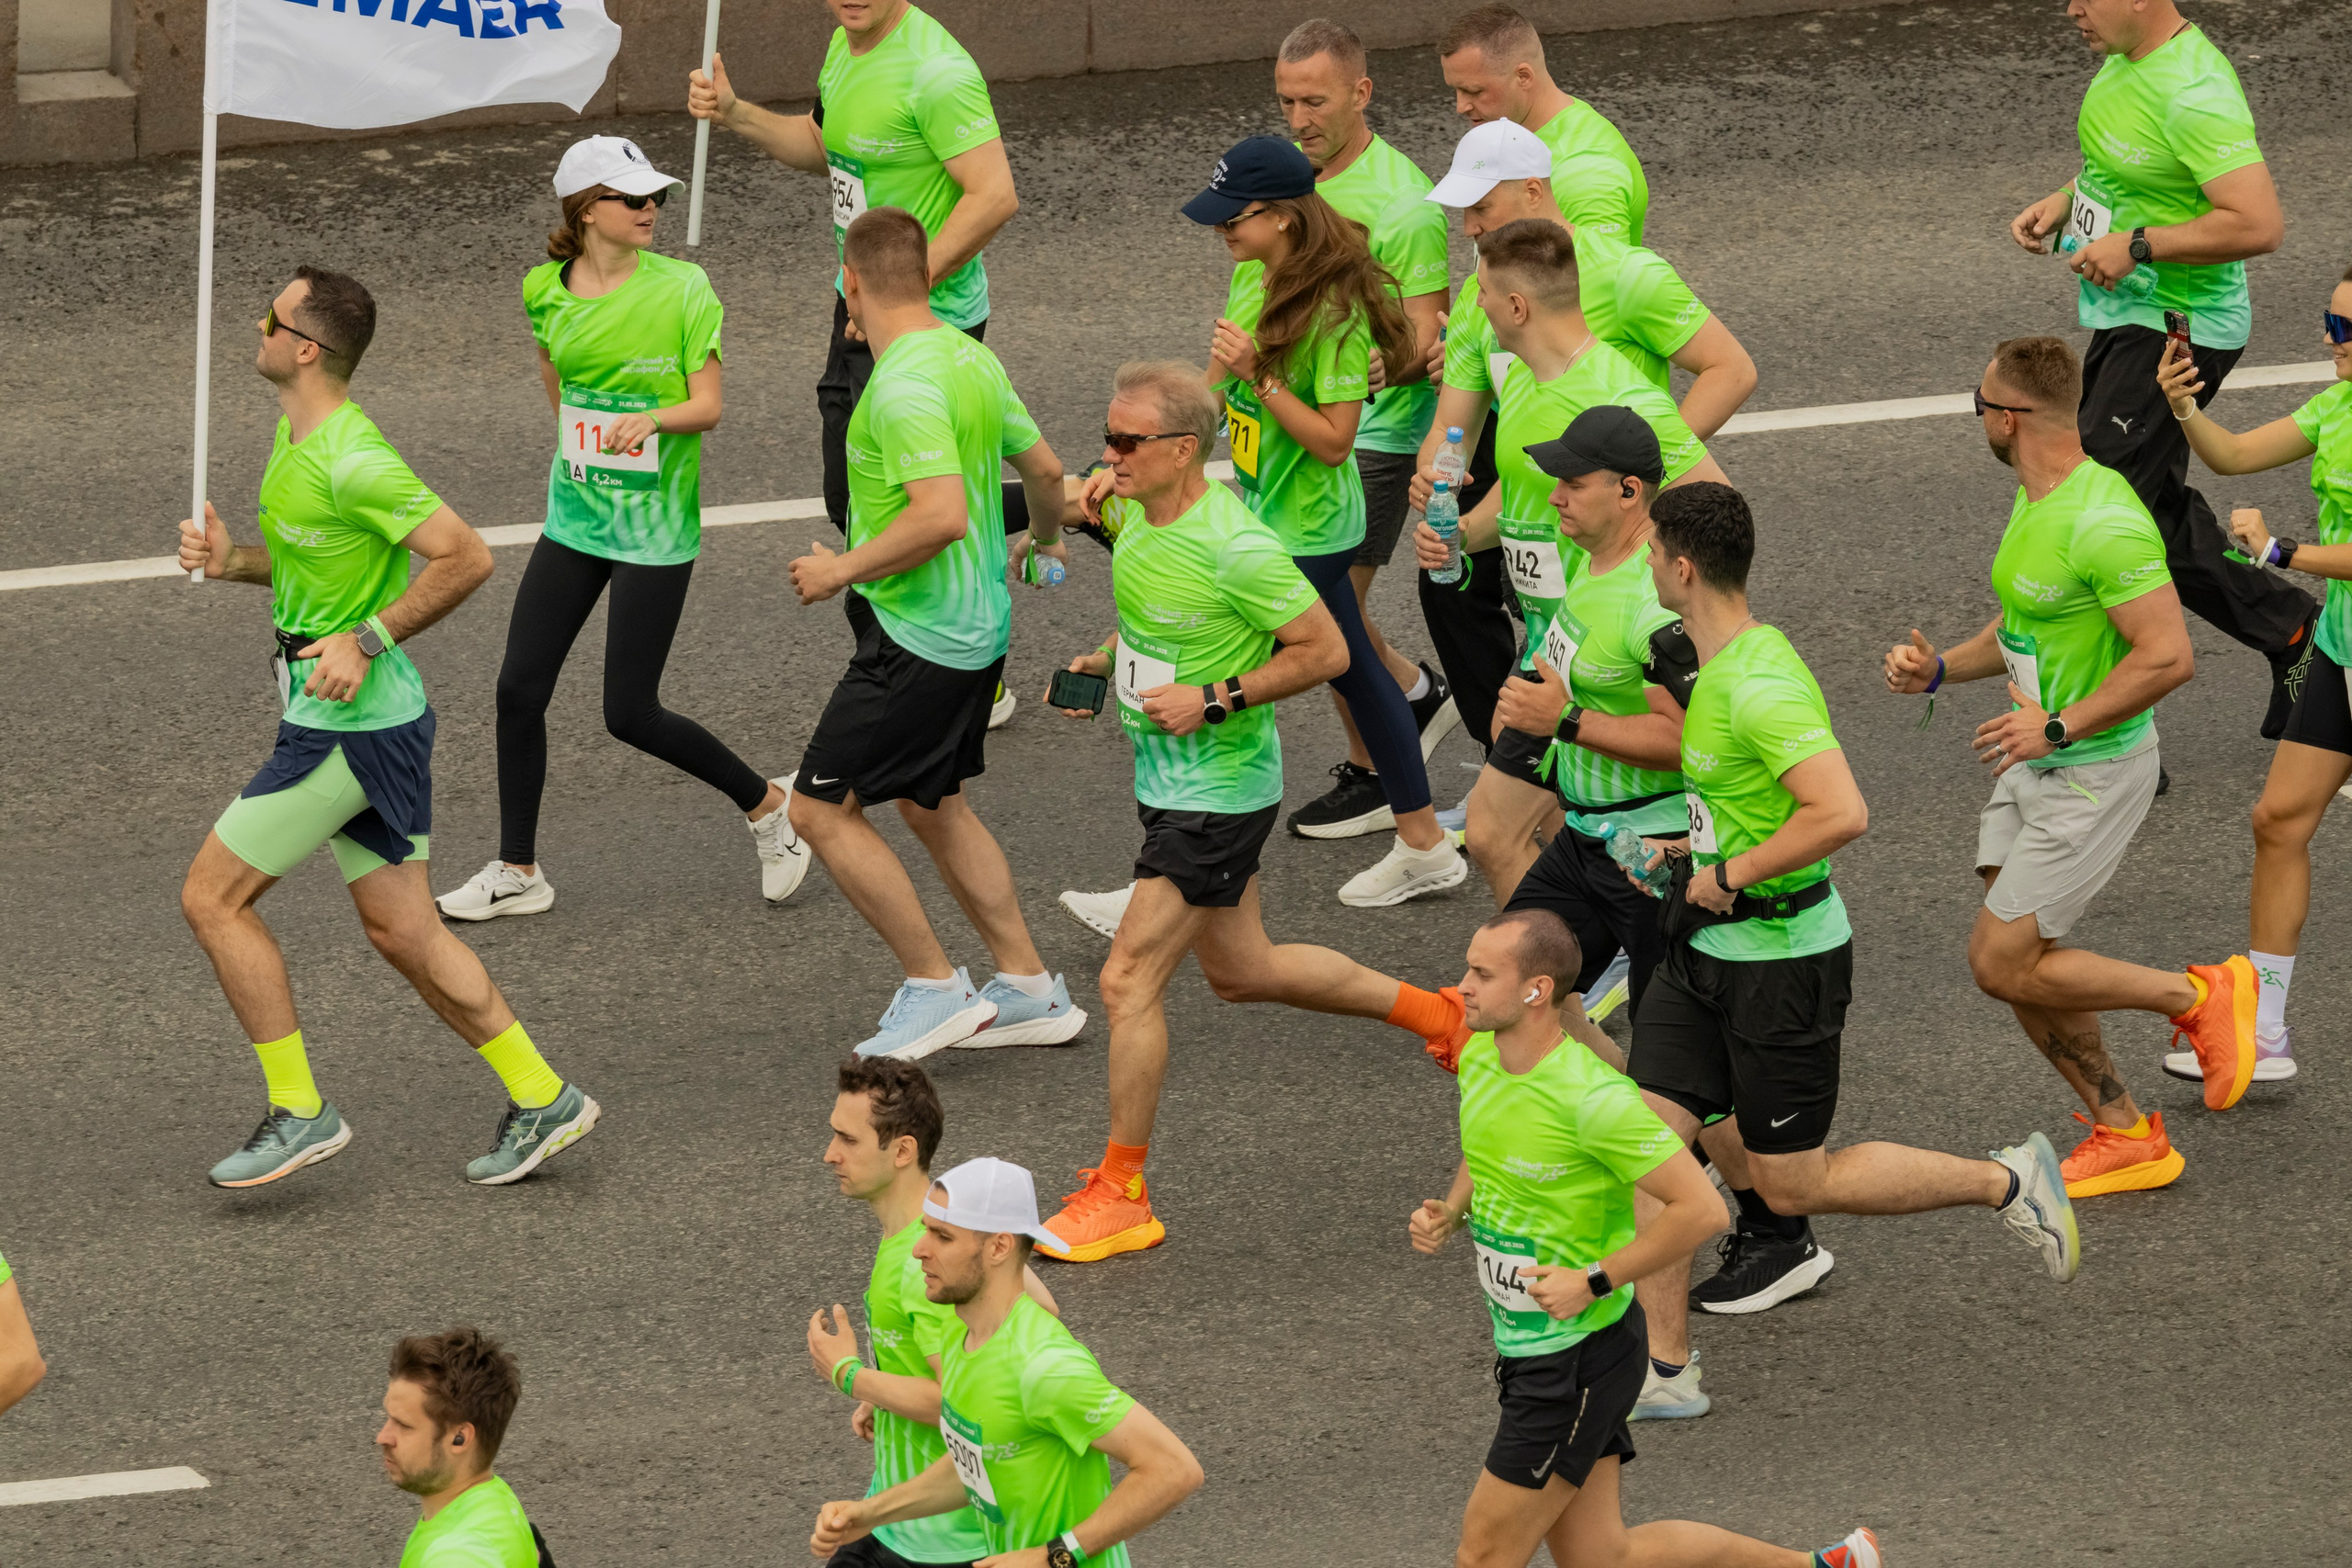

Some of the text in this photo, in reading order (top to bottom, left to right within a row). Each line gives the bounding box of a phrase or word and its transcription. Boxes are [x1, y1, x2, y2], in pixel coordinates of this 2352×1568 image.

[832, 176, 854, 212] 954
[1338, 374, 1363, 386] СБЕР
[1548, 630, 1566, 671] 947
[1128, 660, 1136, 689] 1
[1798, 728, 1827, 742] СБЕР
[945, 1432, 980, 1479] 5007
